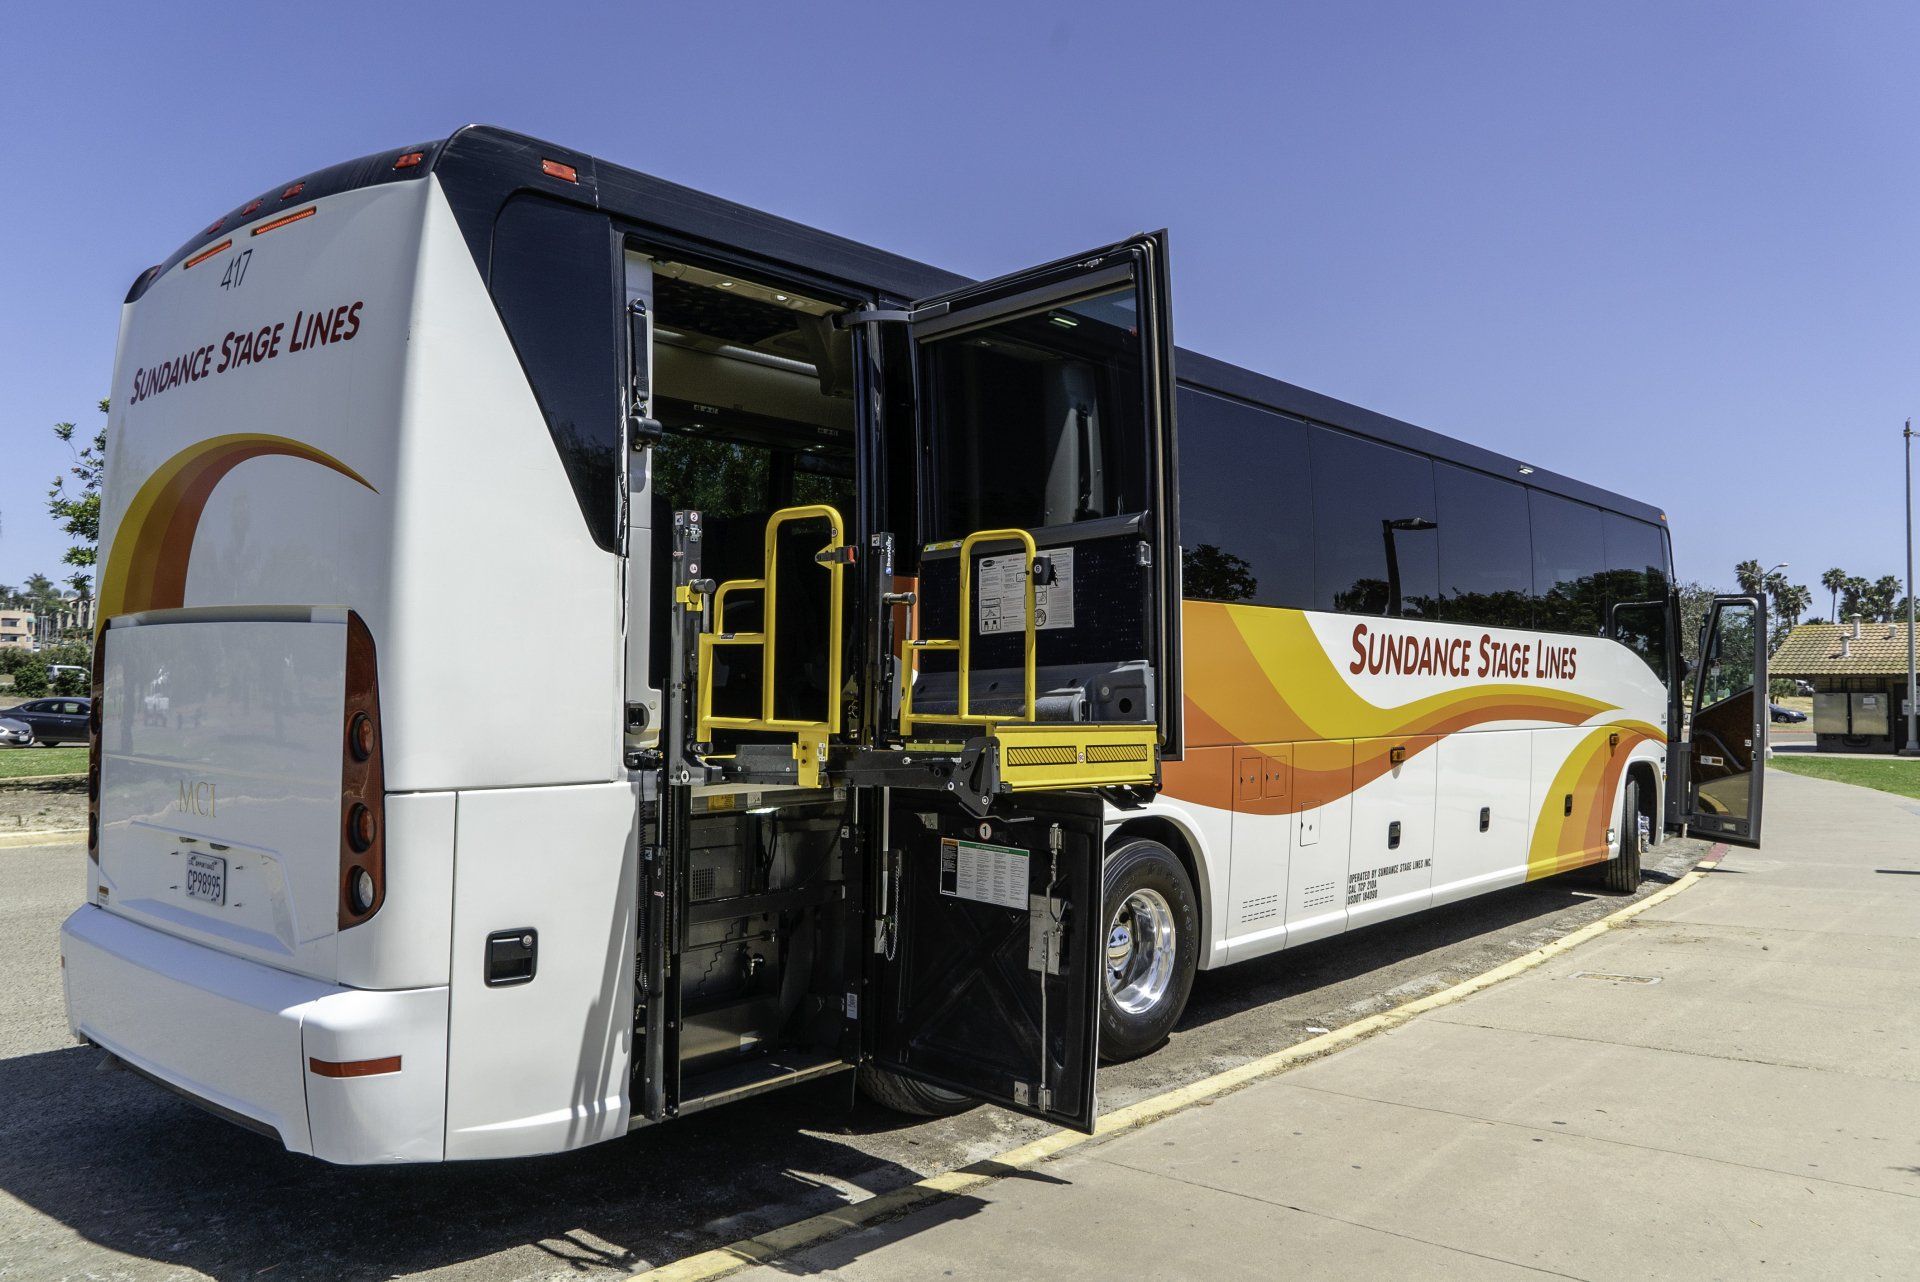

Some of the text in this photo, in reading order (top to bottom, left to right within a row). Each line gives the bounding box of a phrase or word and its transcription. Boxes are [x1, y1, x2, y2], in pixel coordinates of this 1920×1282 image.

[220, 248, 253, 291] 417
[130, 301, 363, 405] SUNDANCE STAGE LINES
[1350, 623, 1577, 680] SUNDANCE STAGE LINES
[179, 779, 216, 818] MCI
[187, 869, 221, 898] CP98995
[1349, 871, 1370, 884] OPERATED
[1371, 869, 1377, 879] BY
[1378, 864, 1399, 877] SUNDANCE
[1400, 861, 1412, 872] STAGE
[1412, 859, 1424, 870] LINES
[1347, 893, 1361, 905] USDOT
[1348, 884, 1356, 894] CAL
